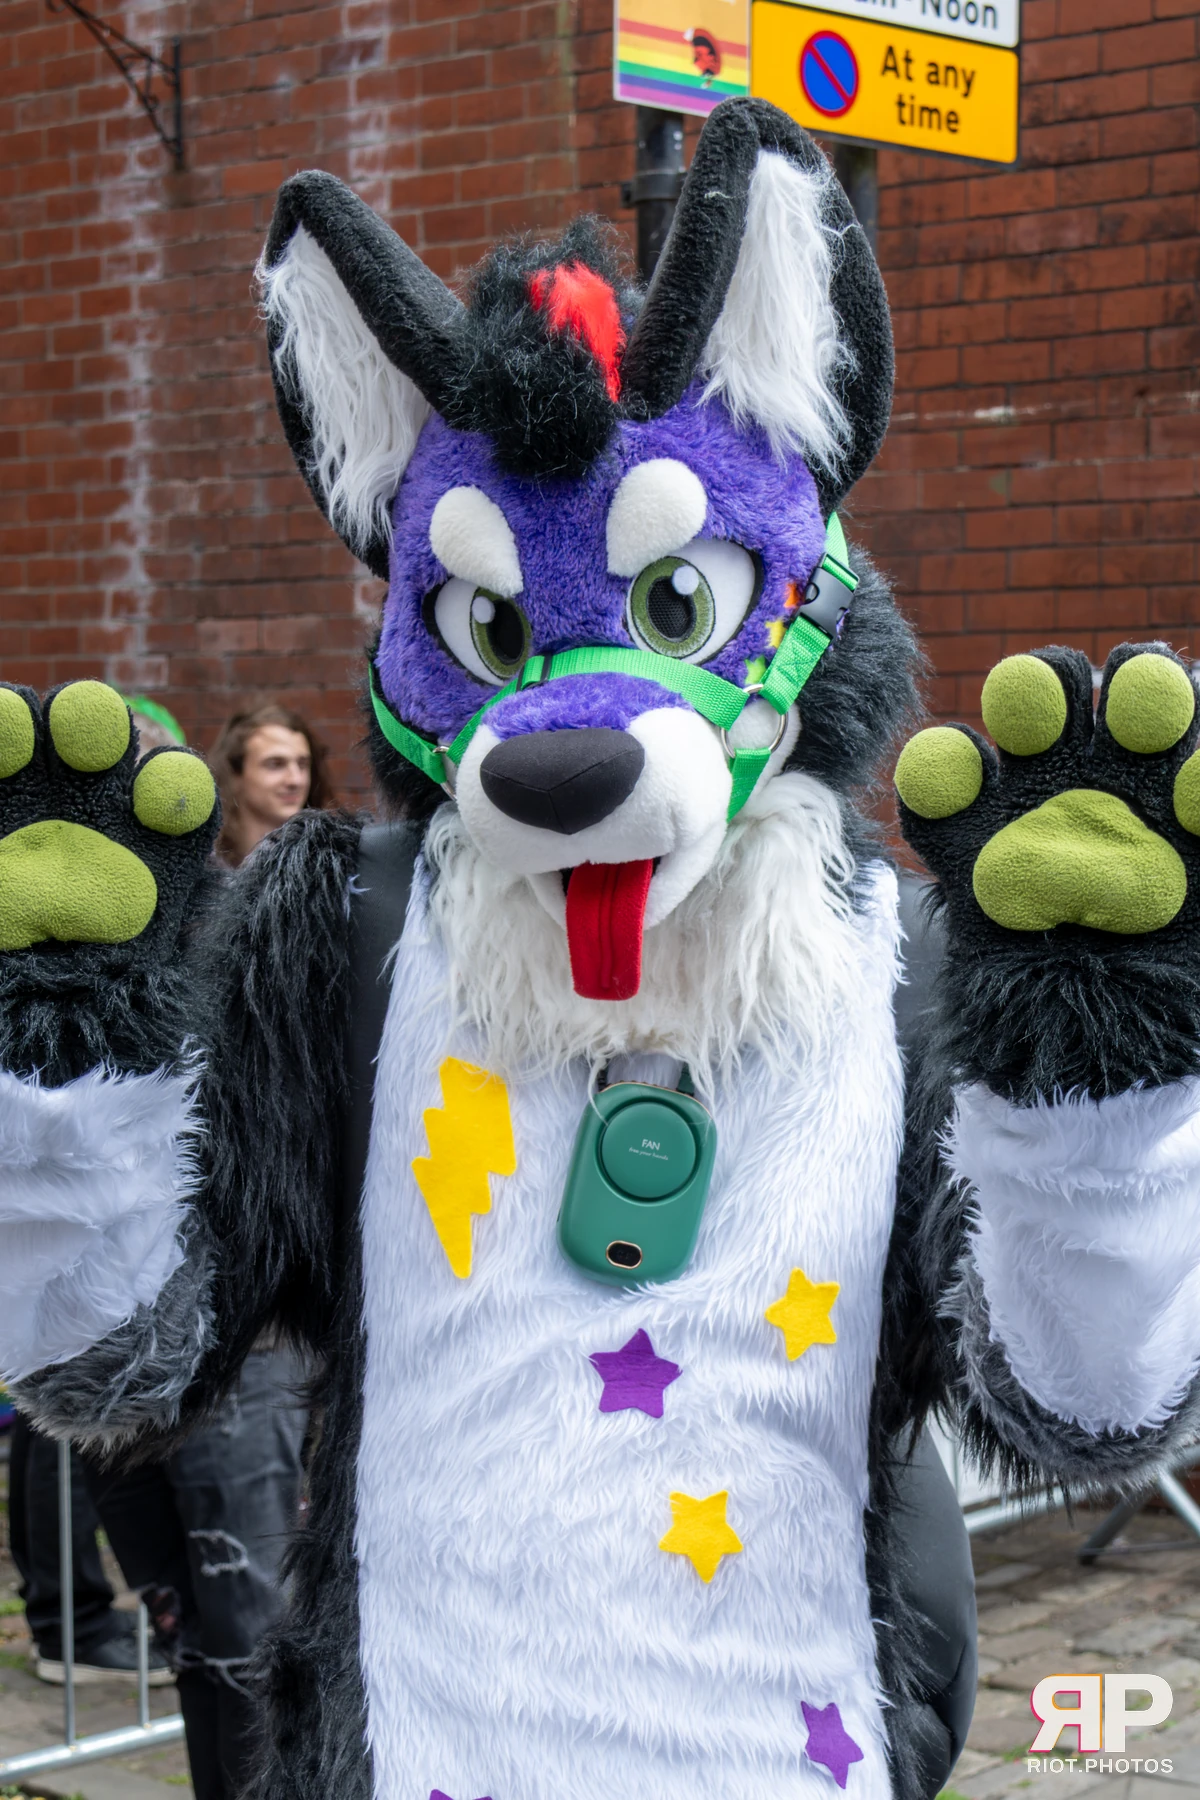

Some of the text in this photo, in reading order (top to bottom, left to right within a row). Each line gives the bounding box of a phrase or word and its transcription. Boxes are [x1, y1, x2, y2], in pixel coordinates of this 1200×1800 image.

[921, 0, 998, 29] Noon
[880, 45, 976, 98] At any
[895, 93, 960, 134] time
[641, 1138, 661, 1151] FAN
